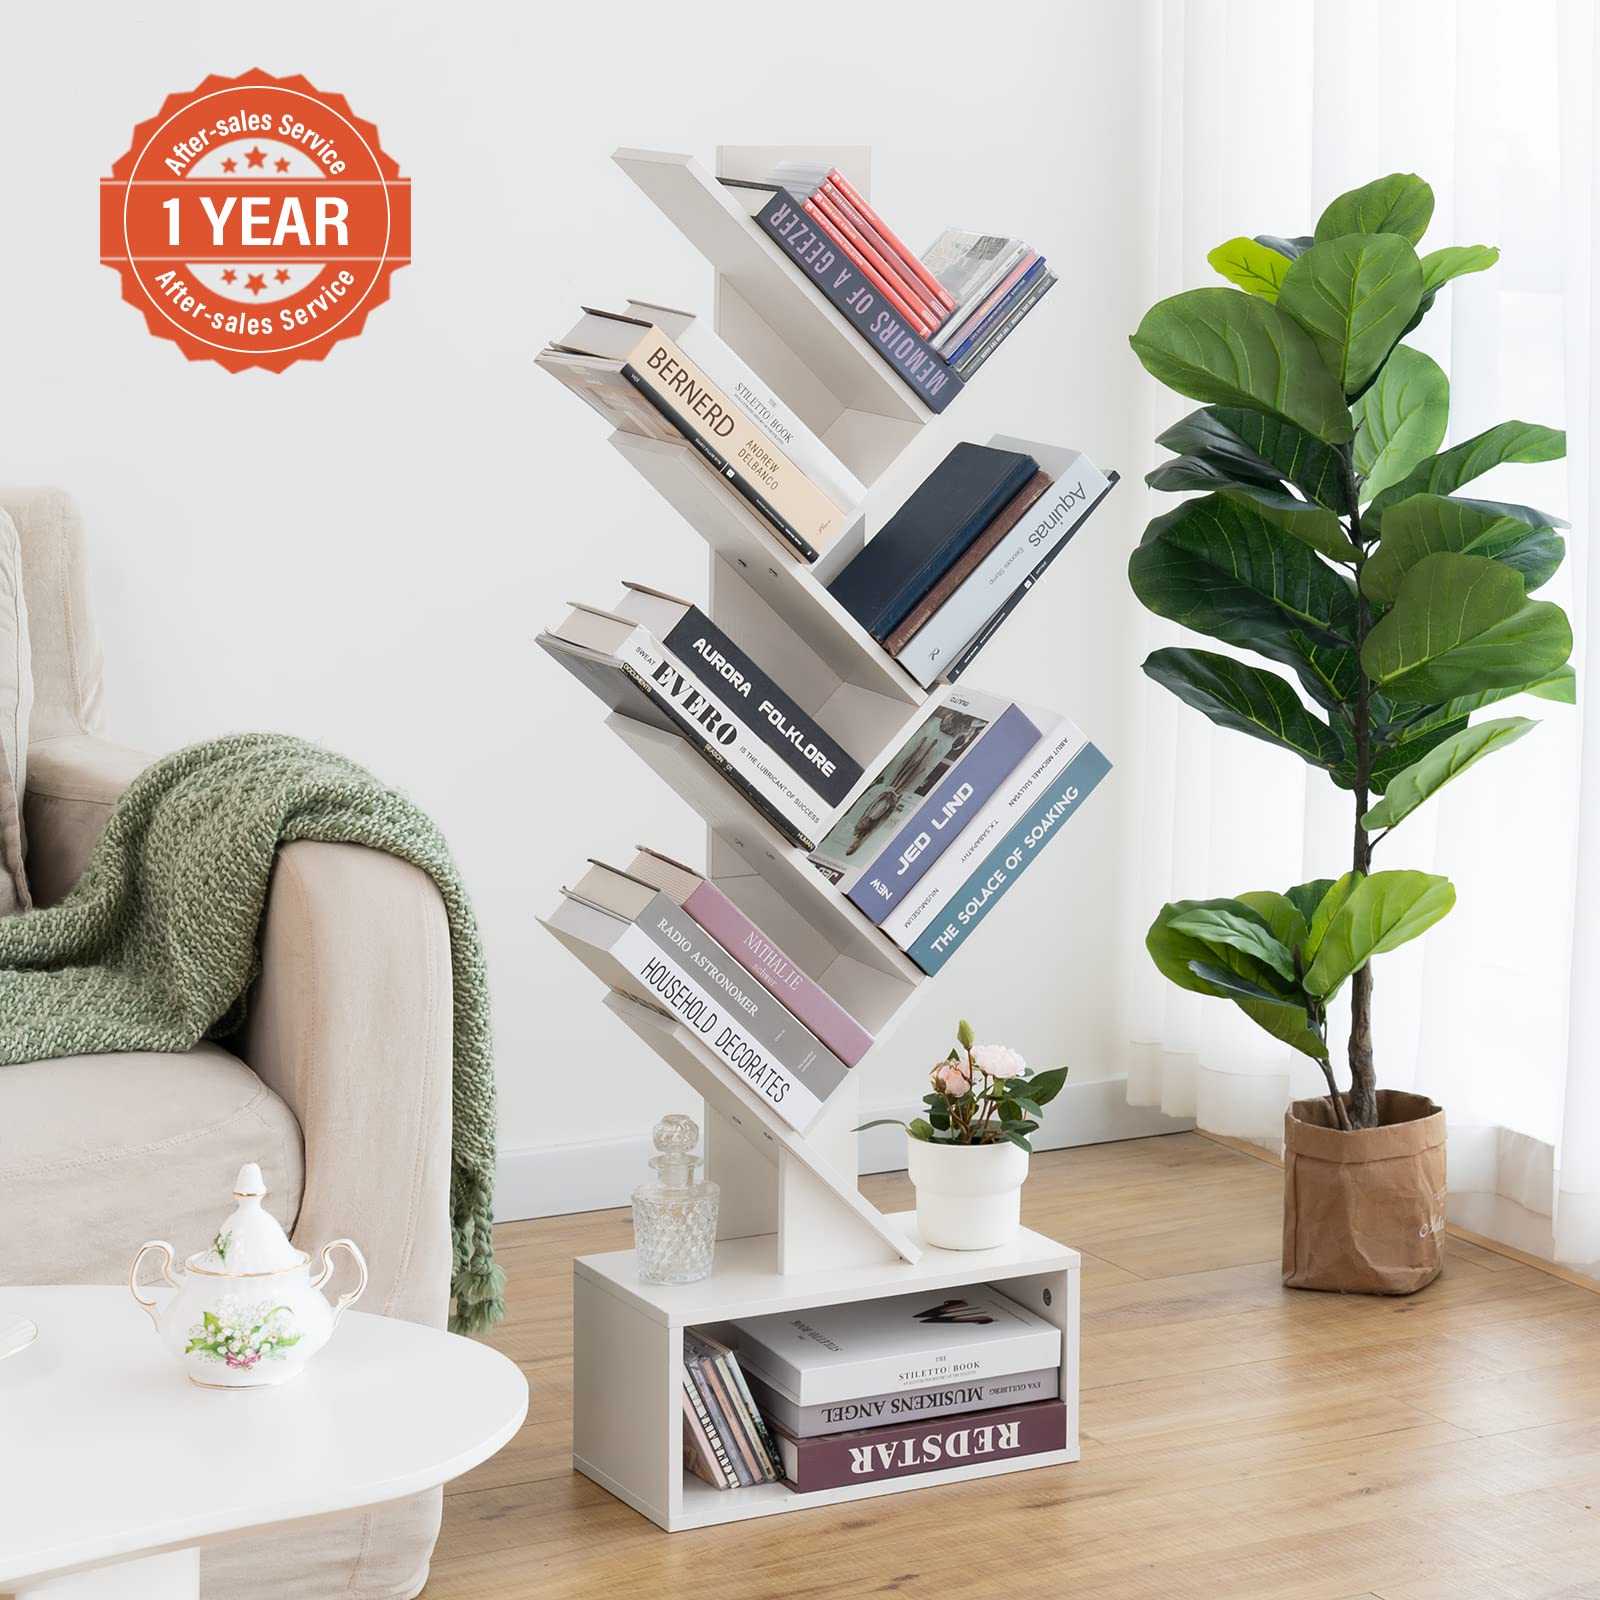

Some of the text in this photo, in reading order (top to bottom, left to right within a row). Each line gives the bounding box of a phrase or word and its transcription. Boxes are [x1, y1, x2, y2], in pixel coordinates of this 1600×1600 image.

[769, 202, 949, 396] MEMOIRS OF A GEEZER
[647, 346, 734, 438] BERNERD
[734, 382, 771, 420] STILETTO
[770, 419, 794, 443] BOOK
[768, 398, 776, 407] THE
[737, 448, 779, 490] DELBANCO
[745, 440, 780, 473] ANDREW
[1029, 481, 1086, 547] Aquinas
[987, 566, 1006, 586] Stump
[636, 646, 820, 824] SWEAT EVERO IS THE LUBRICANT OF SUCCESS
[692, 637, 837, 778] AURORA FOLKLORE
[622, 662, 652, 692] DOCUMENTS
[704, 743, 724, 764] SEASON
[797, 832, 814, 852] HUMAN
[1030, 753, 1054, 780] MICHAEL
[1007, 778, 1033, 807] SULLVIAN
[870, 782, 974, 900] NEW JED LIND
[930, 786, 1079, 954] THE SOLACE OF SOAKING
[902, 887, 939, 928] NIUSMUSEUM
[657, 918, 758, 1016] RADIO ASTRONOMER
[743, 931, 803, 991] NATHALIE
[641, 957, 790, 1103] HOUSEHOLD DECORATES
[898, 1361, 980, 1379] STILETTO BOOK
[988, 1381, 1041, 1395] EVA GULLBERG
[822, 1387, 983, 1424] MUSIKENS ANGEL
[849, 1421, 1021, 1474] REDSTAR
